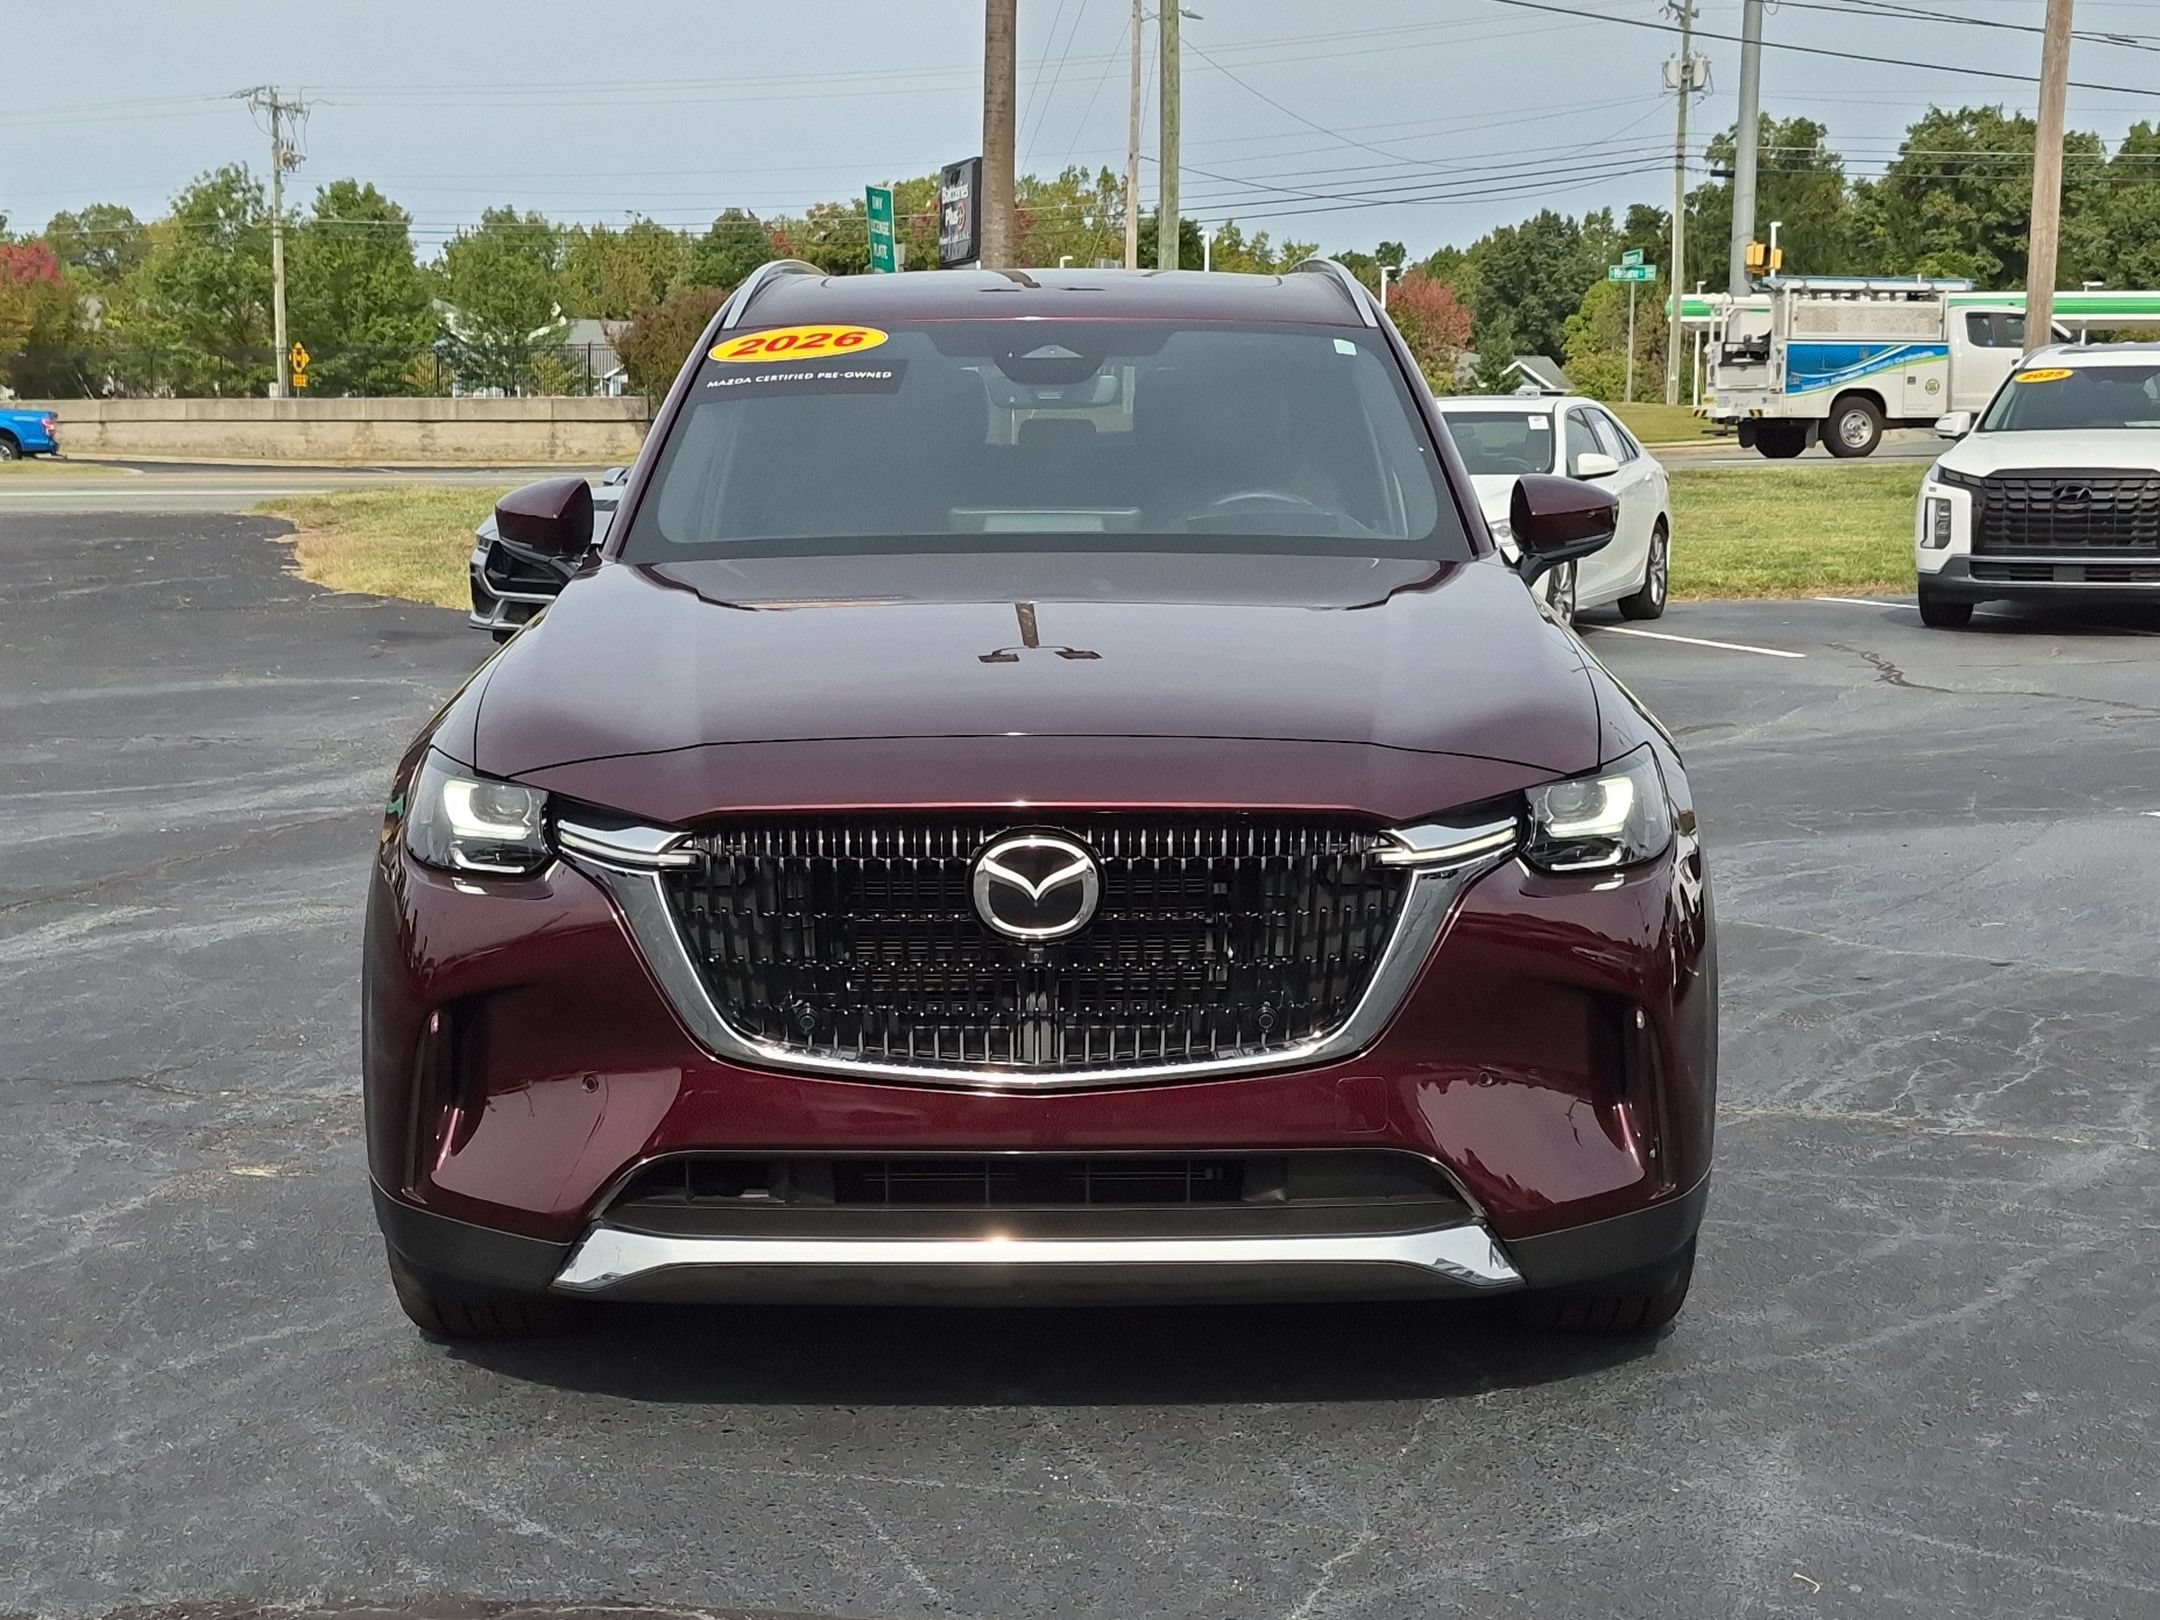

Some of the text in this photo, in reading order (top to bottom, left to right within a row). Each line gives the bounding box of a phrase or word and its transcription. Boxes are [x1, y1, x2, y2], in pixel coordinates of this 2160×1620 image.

[727, 331, 868, 358] 2026
[706, 371, 892, 388] MAZDA CERTIFIED PRE-OWNED
